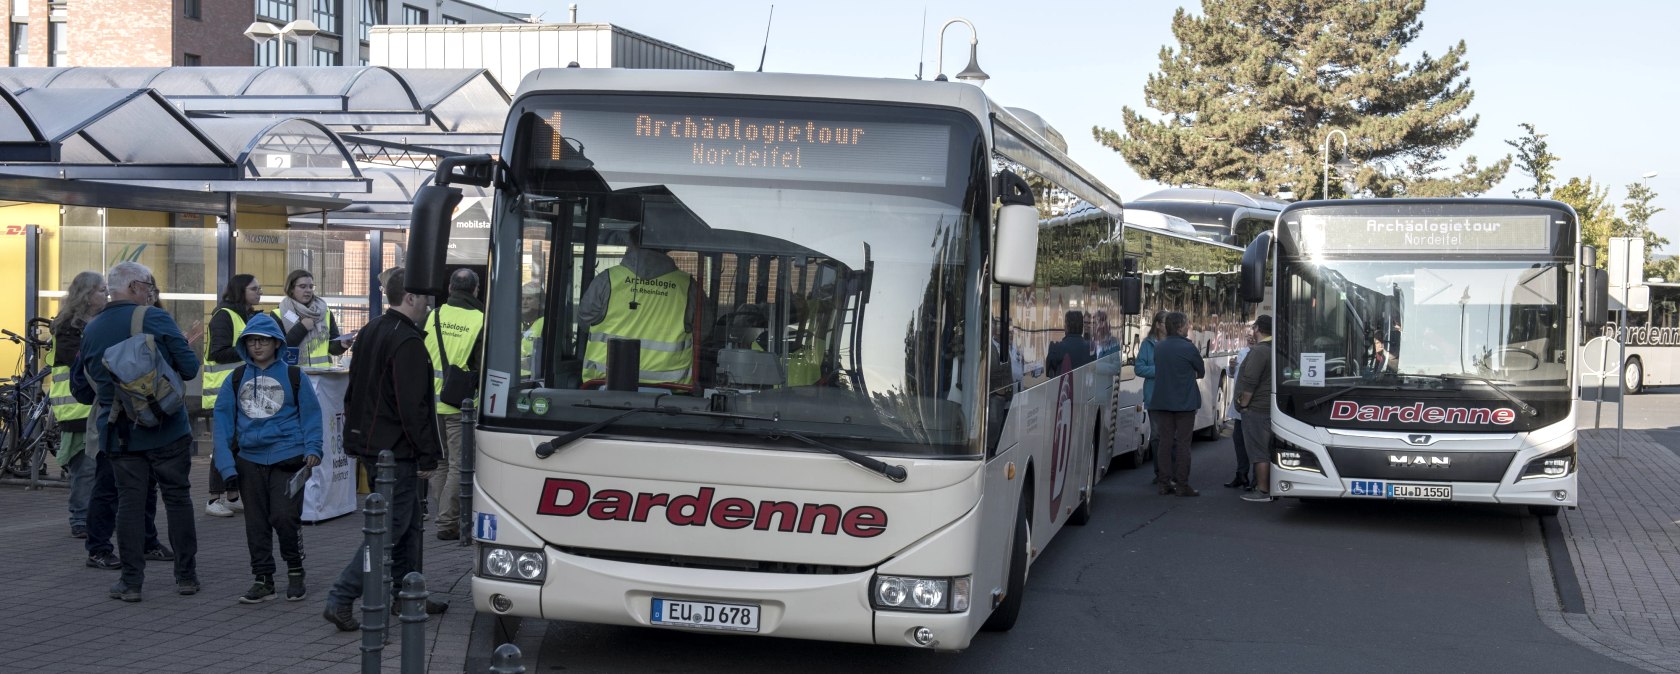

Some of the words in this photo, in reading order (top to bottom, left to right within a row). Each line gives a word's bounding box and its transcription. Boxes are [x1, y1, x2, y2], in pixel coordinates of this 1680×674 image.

[543, 112, 562, 160] 1
[636, 114, 865, 144] Archäologietour
[692, 142, 802, 168] Nordeifel
[456, 220, 491, 229] mobilsta
[1366, 219, 1501, 234] Archäologietour
[1404, 232, 1463, 246] Nordeifel
[1601, 321, 1680, 346] Dardenn
[1307, 365, 1317, 378] 5
[489, 393, 497, 414] 1
[1329, 400, 1516, 426] Dardenne
[1388, 455, 1451, 467] MAN
[1393, 486, 1408, 497] EU
[1414, 486, 1422, 497] D
[1423, 487, 1450, 498] 1550
[536, 477, 889, 538] Dardenne
[669, 602, 692, 621] EU
[703, 605, 715, 623] D
[718, 606, 751, 626] 678
